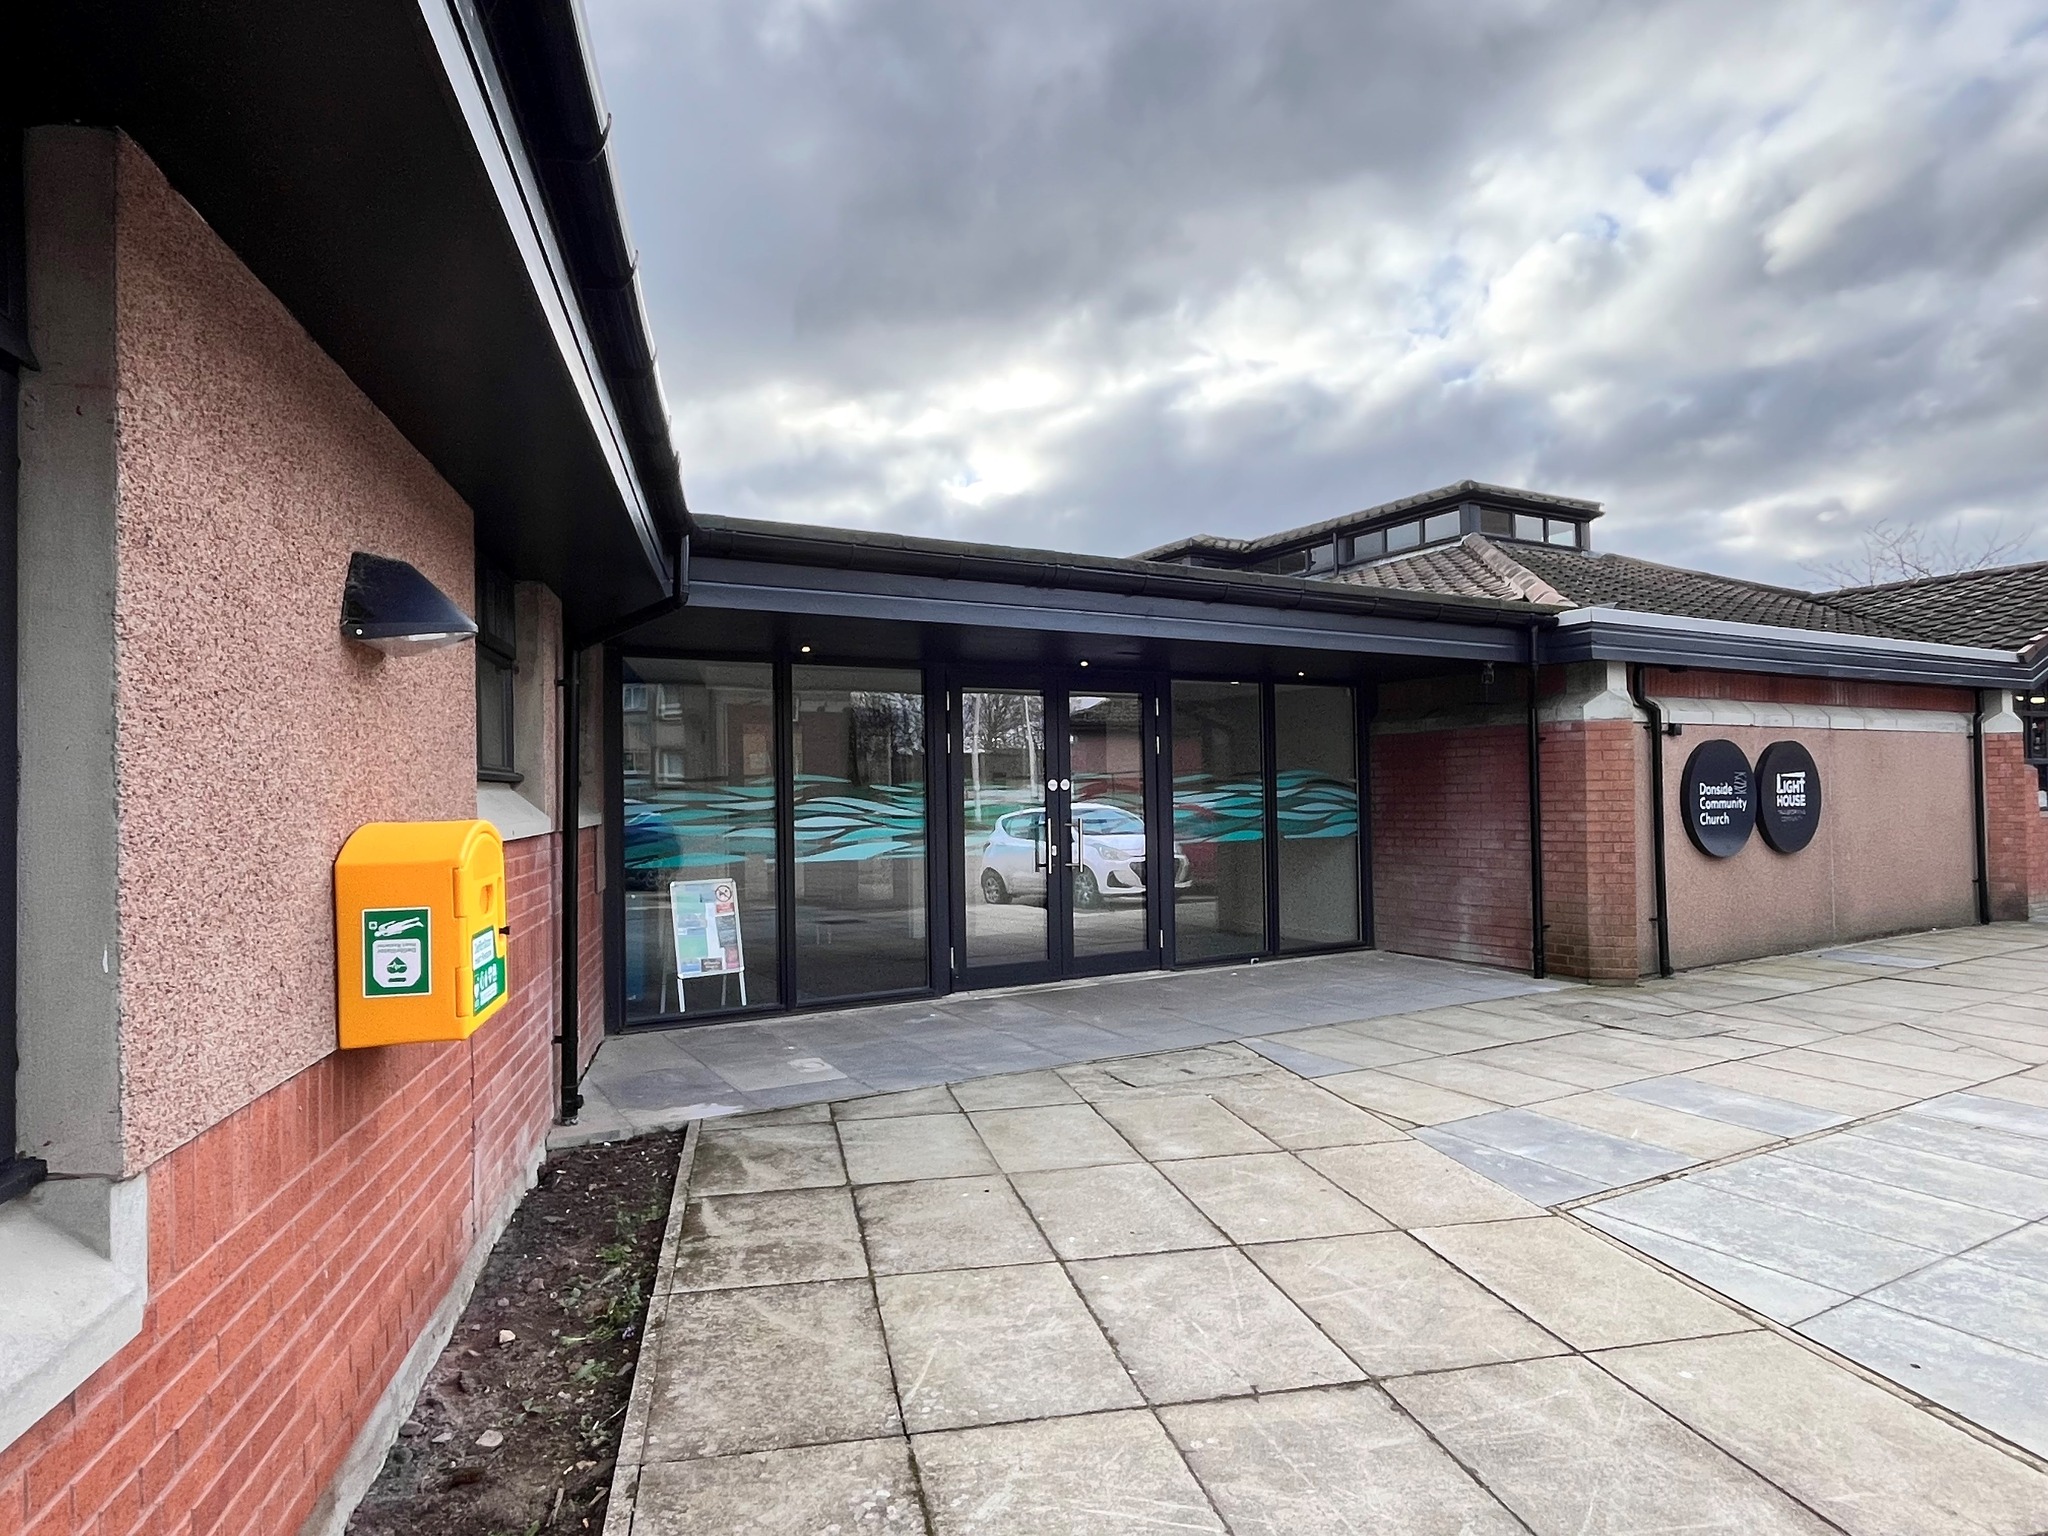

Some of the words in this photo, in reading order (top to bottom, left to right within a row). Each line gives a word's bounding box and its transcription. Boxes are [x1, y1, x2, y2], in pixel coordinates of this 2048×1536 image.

[1699, 782, 1733, 796] Donside
[1699, 796, 1747, 812] Community
[1776, 795, 1806, 807] HOUSE
[1699, 812, 1730, 825] Church
